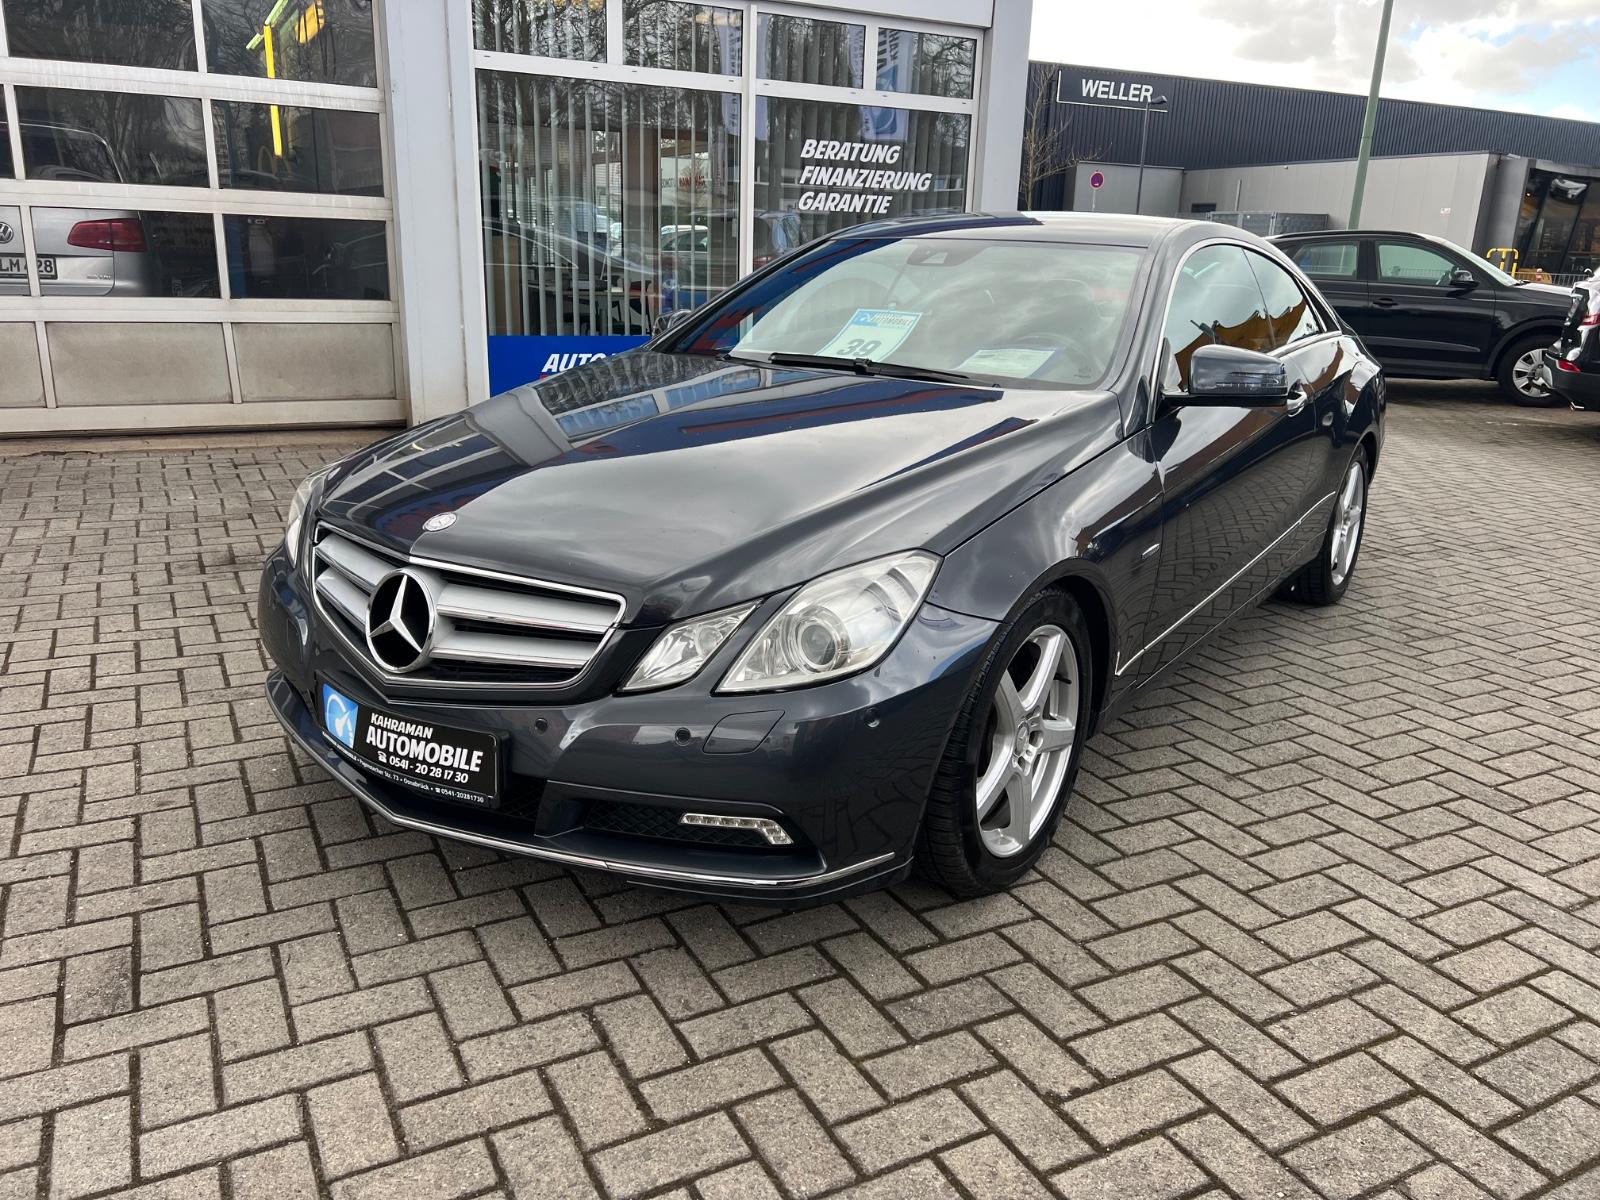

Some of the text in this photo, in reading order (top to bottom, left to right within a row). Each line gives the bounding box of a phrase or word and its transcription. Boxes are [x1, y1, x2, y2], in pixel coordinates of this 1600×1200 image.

[1081, 78, 1154, 103] WELLER
[800, 138, 901, 164] BERATUNG
[799, 165, 933, 191] FINANZIERUNG
[798, 191, 893, 214] GARANTIE
[24, 259, 53, 273] 28
[836, 338, 882, 357] 39
[370, 712, 433, 739] KAHRAMAN
[366, 725, 484, 772] AUTOMOBILE
[389, 755, 409, 770] 0541
[414, 763, 428, 775] 20
[429, 766, 443, 778] 28
[443, 769, 453, 780] 17
[454, 771, 469, 784] 30
